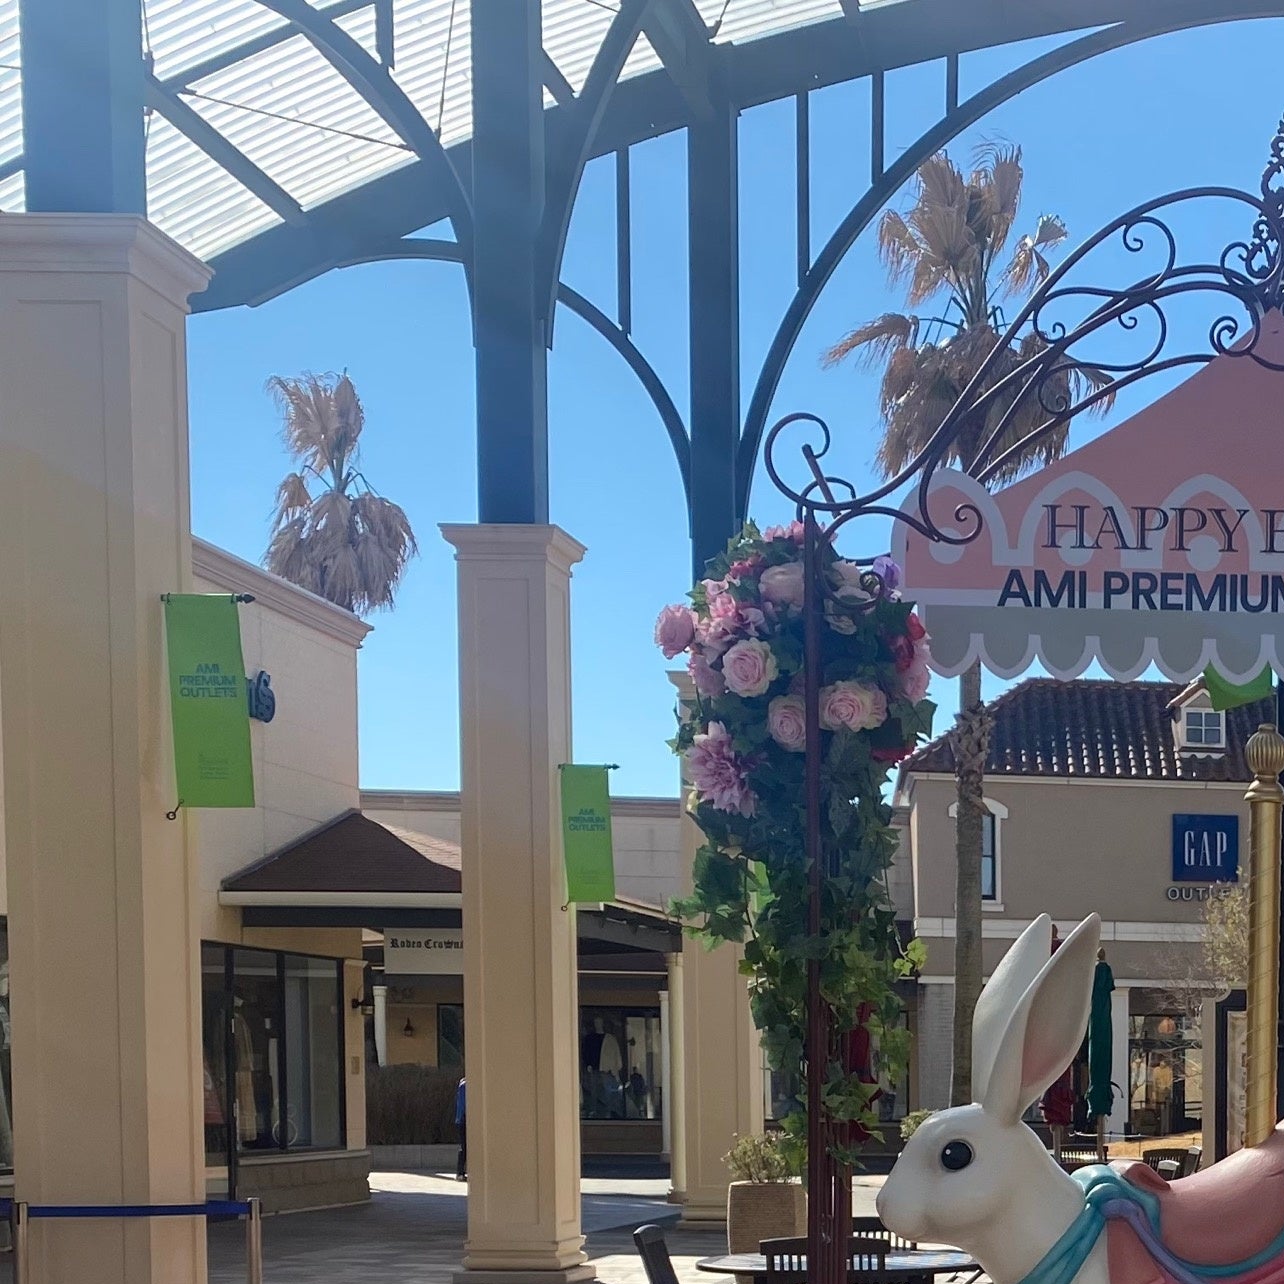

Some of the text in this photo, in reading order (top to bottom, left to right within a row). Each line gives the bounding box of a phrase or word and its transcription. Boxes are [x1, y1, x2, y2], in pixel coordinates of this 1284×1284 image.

[1042, 504, 1250, 553] HAPPY
[997, 569, 1087, 609] AMI
[180, 675, 237, 686] PREMIUM
[195, 663, 220, 674] AMI
[180, 687, 238, 698] OUTLETS
[1184, 830, 1228, 867] GAP
